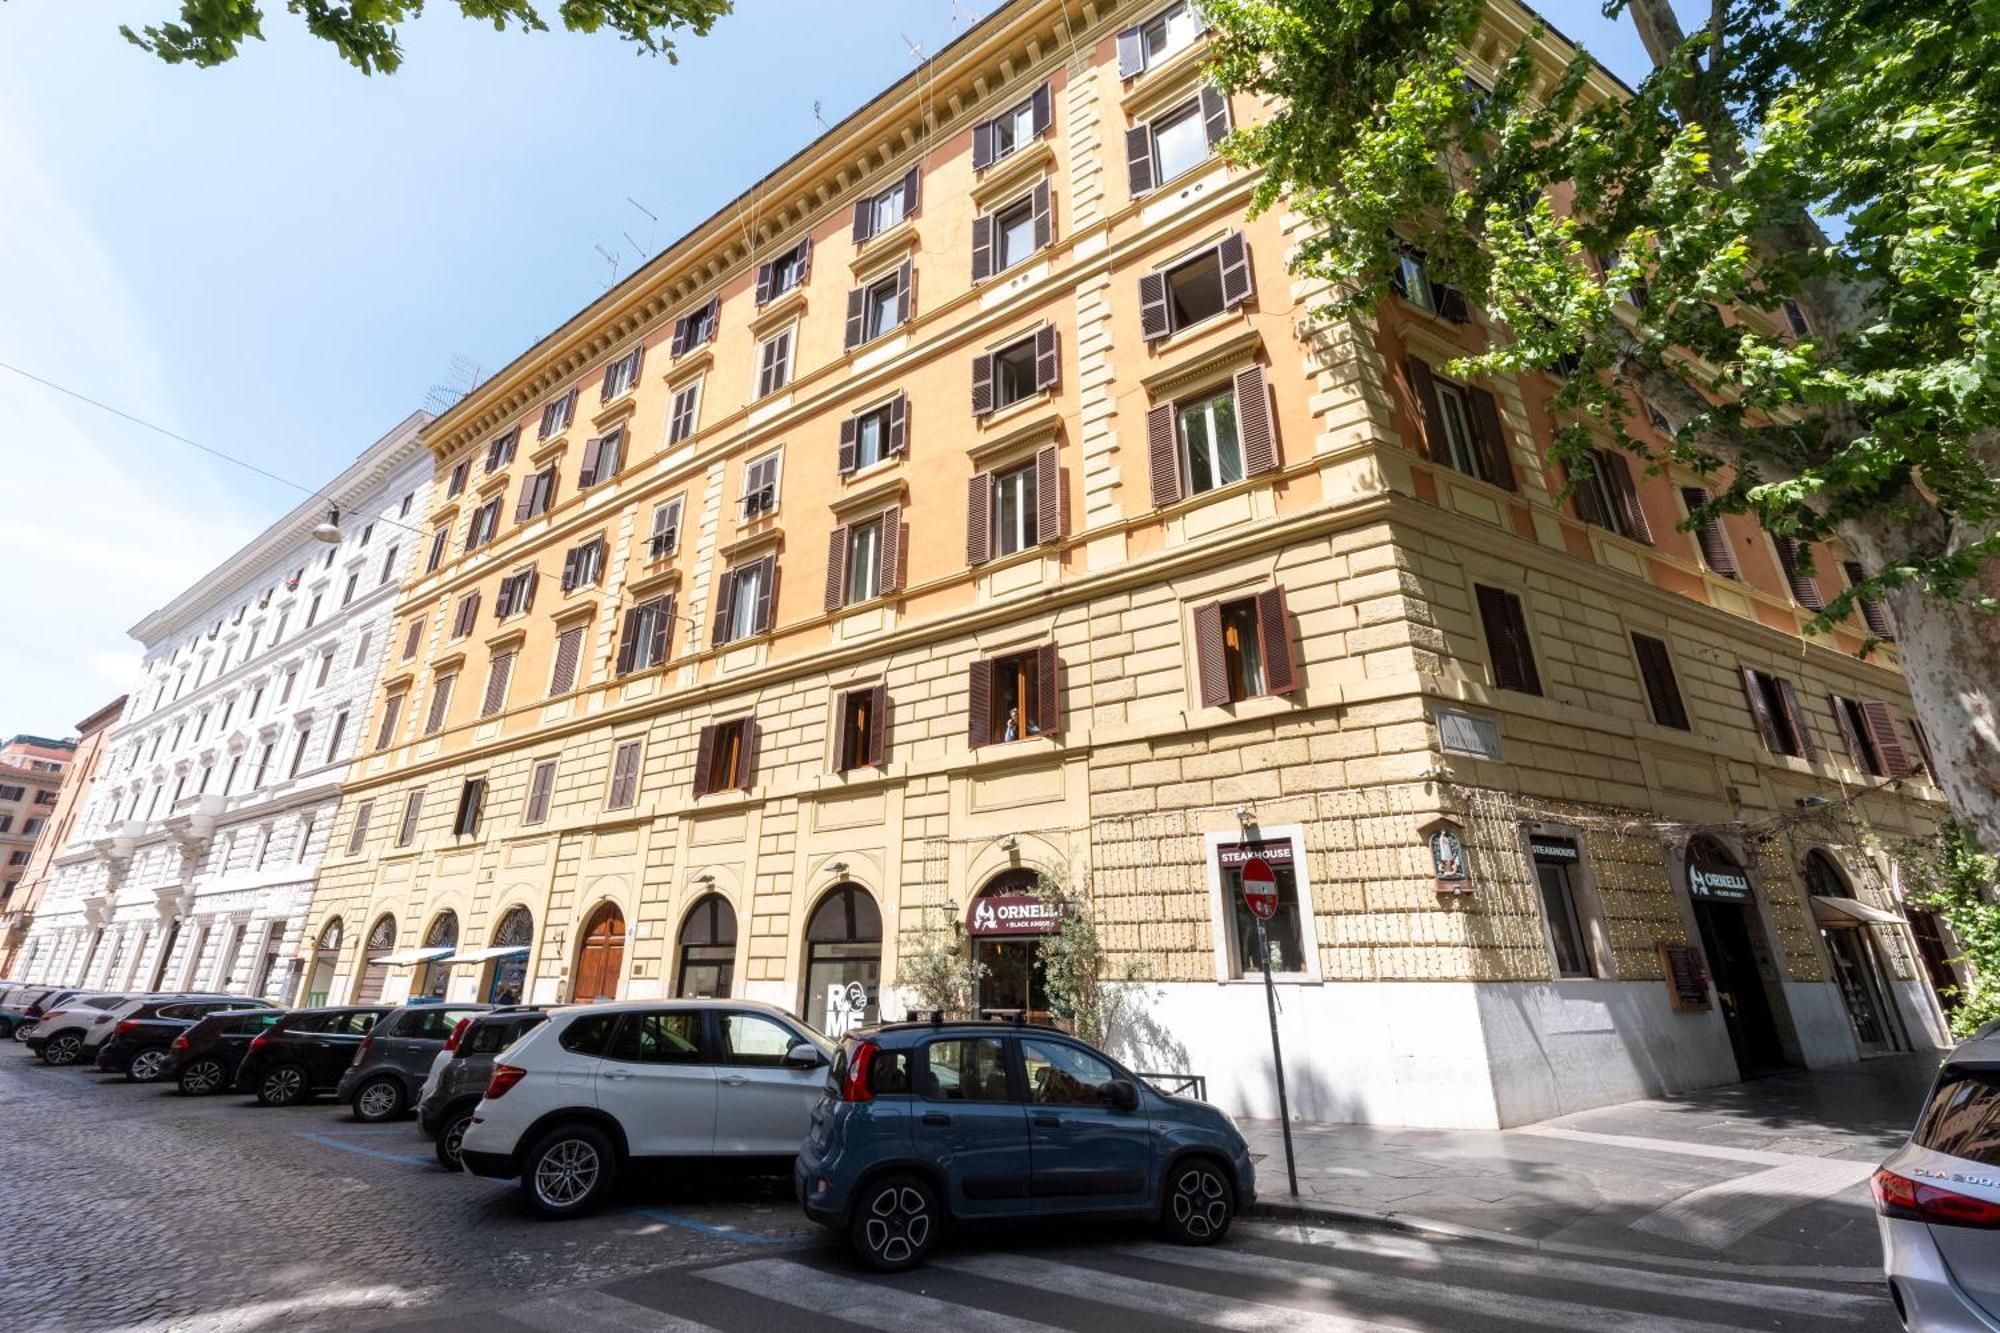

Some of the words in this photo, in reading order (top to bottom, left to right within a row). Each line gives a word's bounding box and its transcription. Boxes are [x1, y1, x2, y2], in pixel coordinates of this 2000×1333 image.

[1222, 848, 1292, 862] STEAKHOUSE
[1531, 844, 1577, 858] STEAKHOUSE
[1704, 873, 1748, 890] ORNELLI
